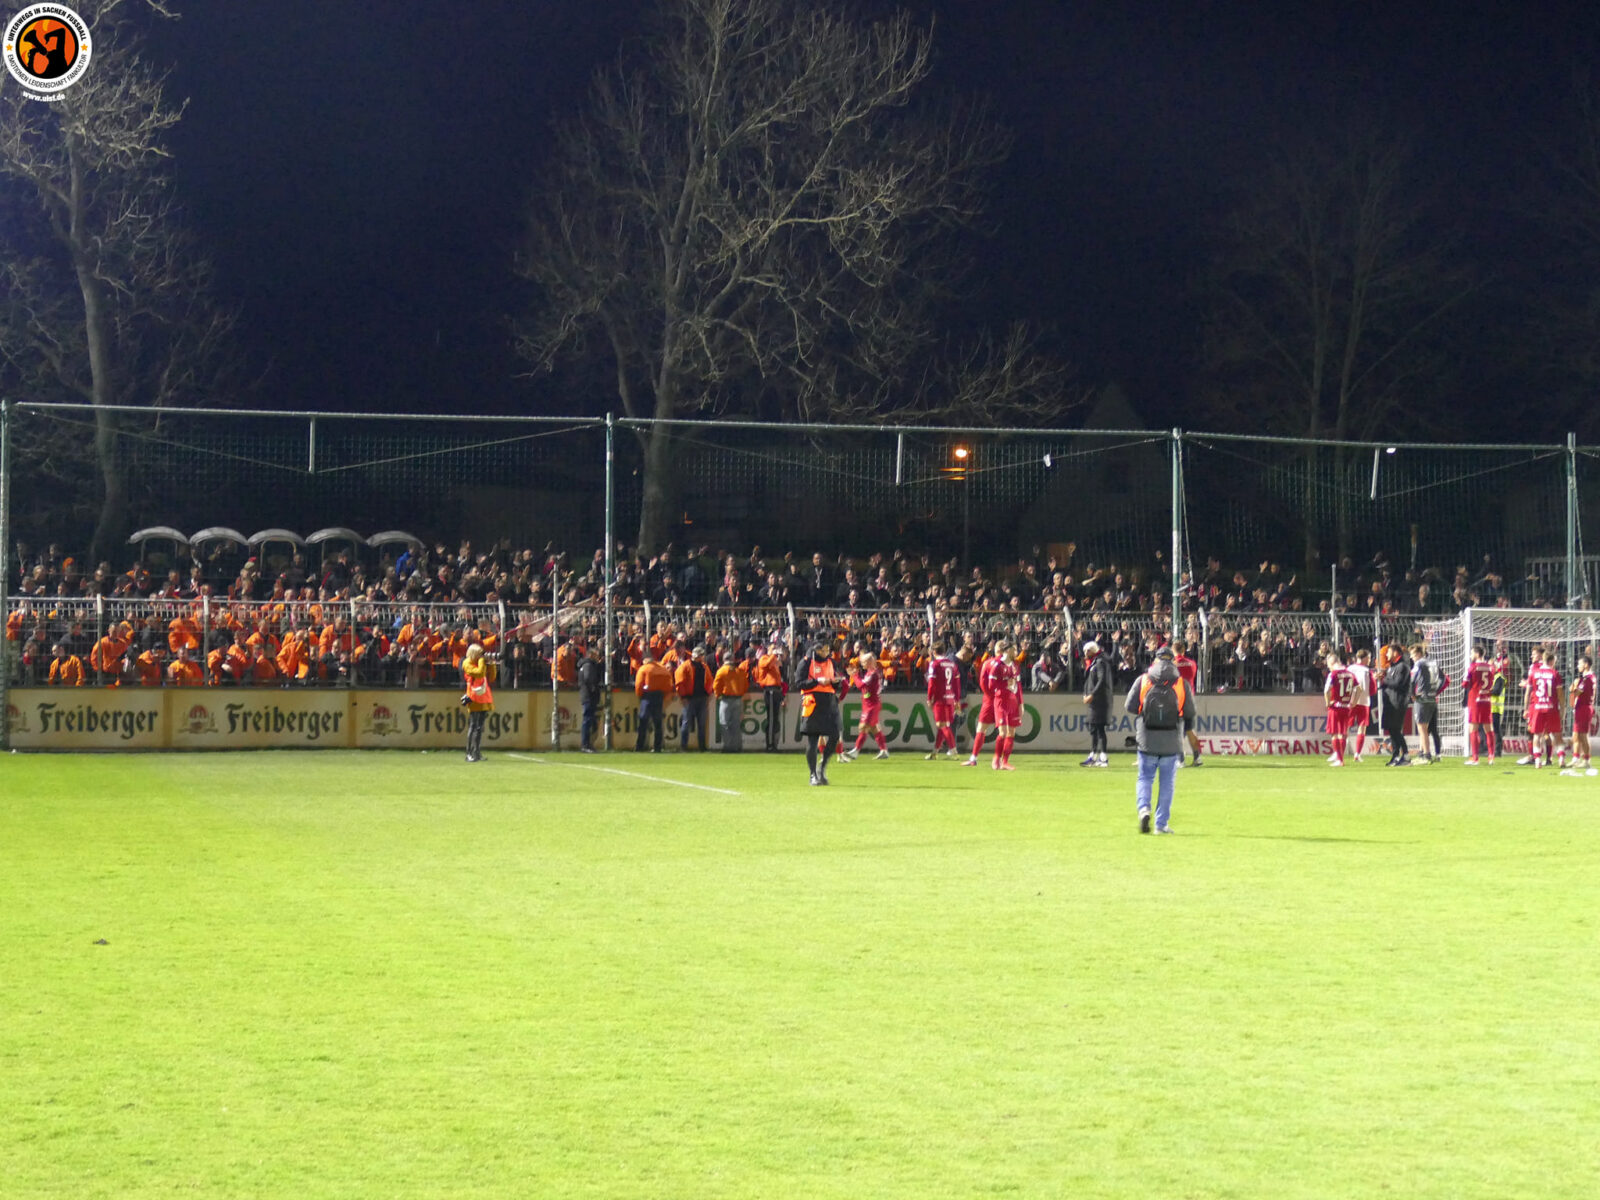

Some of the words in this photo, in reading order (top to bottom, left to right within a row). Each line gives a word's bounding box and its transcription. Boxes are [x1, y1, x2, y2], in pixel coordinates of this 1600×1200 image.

[944, 667, 953, 686] 9
[1481, 671, 1490, 690] 5
[1338, 678, 1353, 697] 14
[1535, 679, 1553, 698] 31
[37, 702, 158, 739] Freiberger
[225, 703, 343, 740] Freiberger
